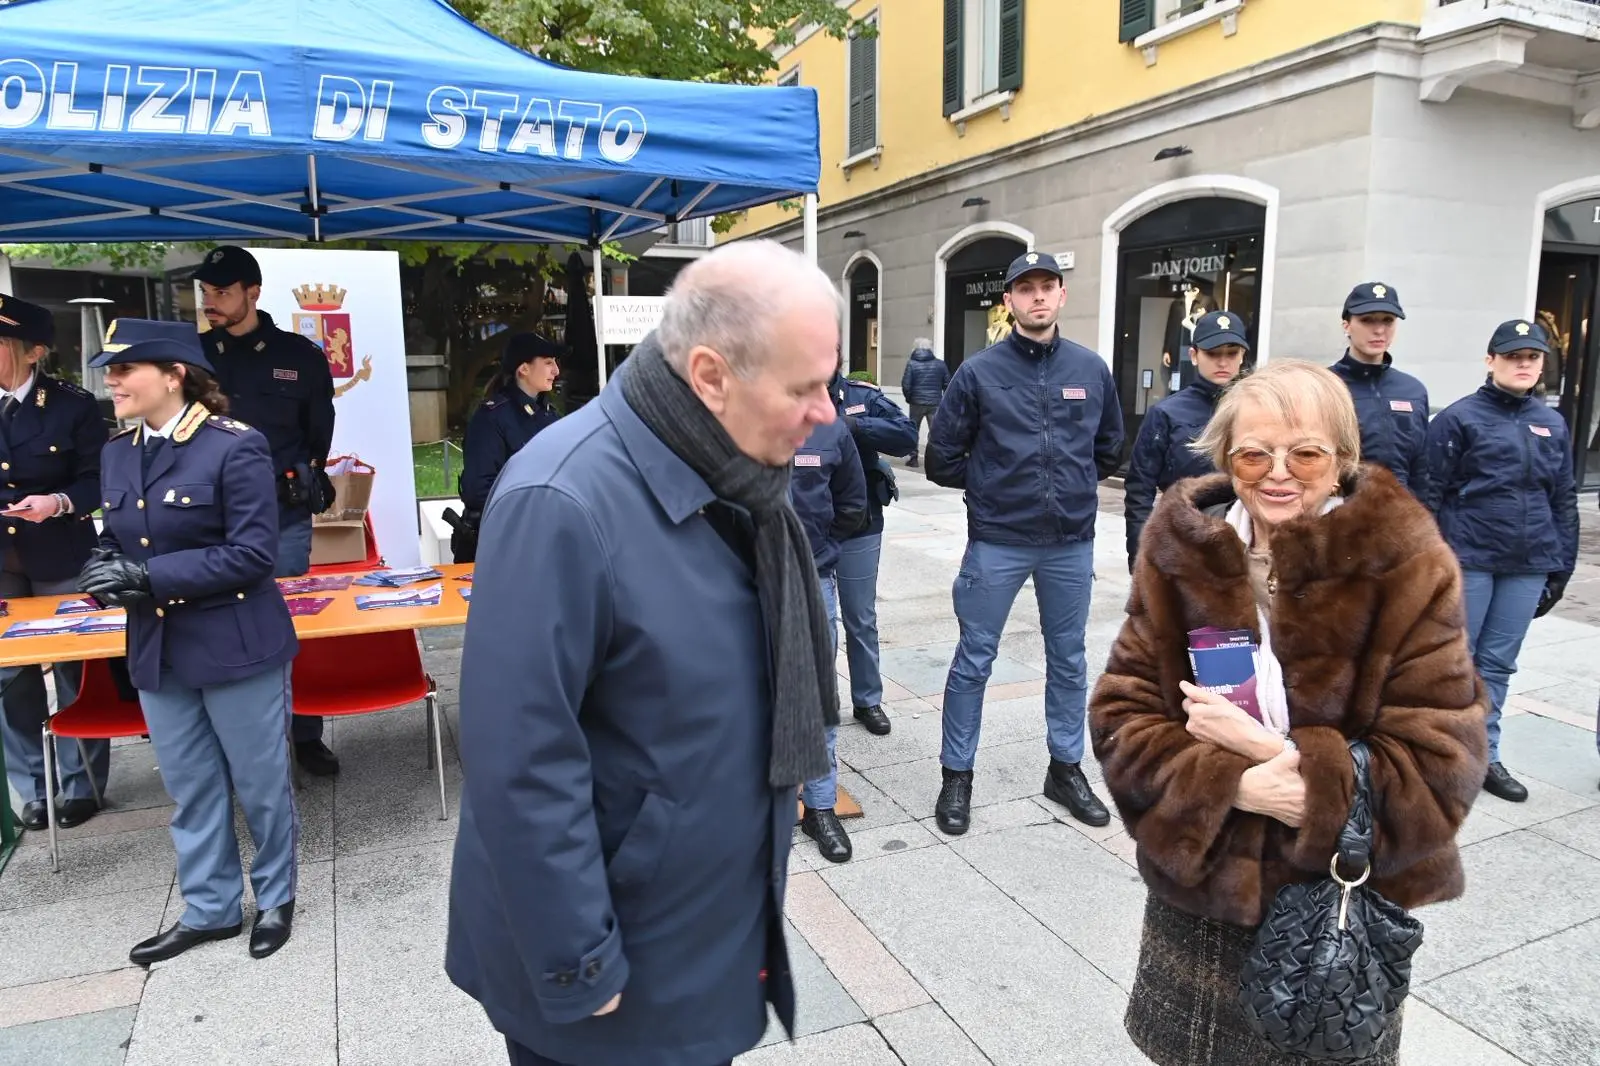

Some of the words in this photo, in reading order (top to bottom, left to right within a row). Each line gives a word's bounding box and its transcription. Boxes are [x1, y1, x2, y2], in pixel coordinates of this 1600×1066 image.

[312, 74, 394, 142] DI
[421, 85, 647, 163] STATO
[1151, 260, 1181, 277] DAN
[1181, 254, 1226, 279] JOHN
[966, 282, 984, 296] DAN
